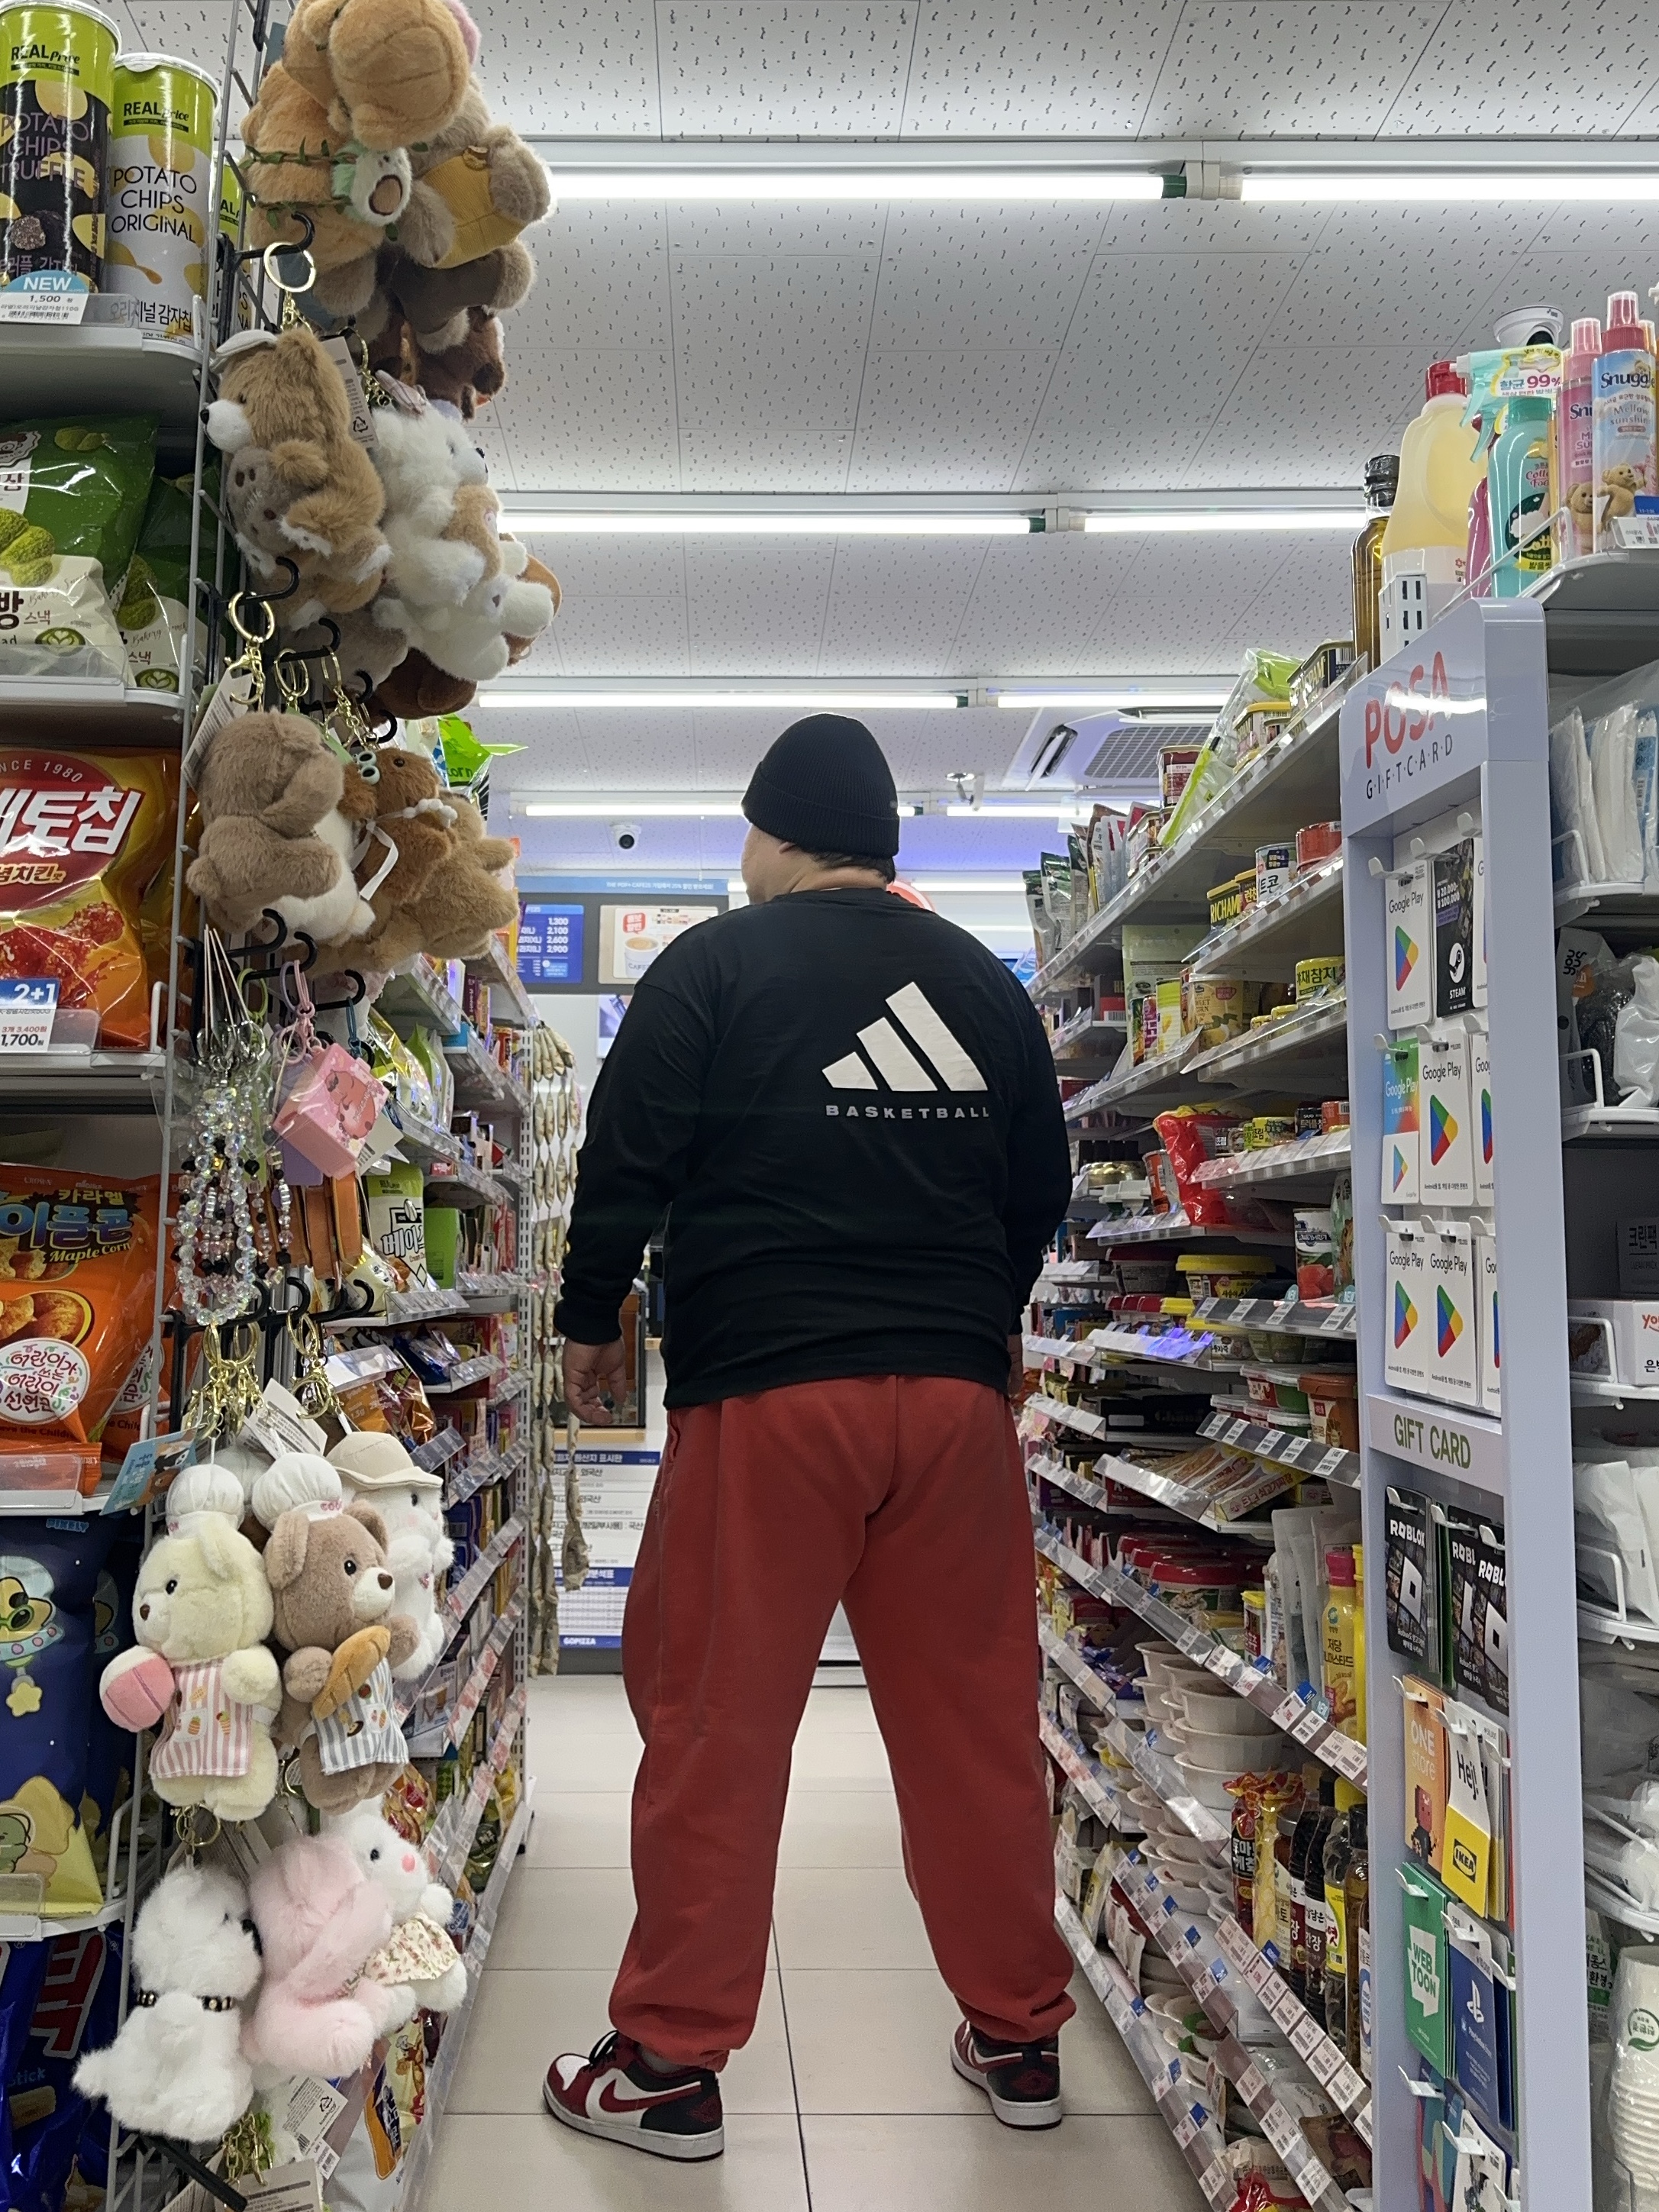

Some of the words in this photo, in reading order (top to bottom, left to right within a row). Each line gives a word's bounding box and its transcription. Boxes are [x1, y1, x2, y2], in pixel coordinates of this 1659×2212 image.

[124, 102, 161, 117] REAL
[114, 166, 197, 194] POTATO
[121, 189, 185, 214] CHIPS
[111, 214, 196, 244] ORIGINAL
[23, 277, 72, 291] NEW
[157, 303, 192, 334] 감자칩
[1499, 379, 1525, 391] 항균
[1600, 371, 1655, 390] Snuggle
[128, 650, 151, 664] 스낵
[1364, 651, 1451, 770] POSA
[43, 760, 83, 783] 1980
[1209, 896, 1239, 923] RICHAM
[1389, 893, 1411, 914] Google
[1411, 890, 1424, 907] Play
[14, 983, 56, 1005] 2+1
[1450, 987, 1466, 999] STEAM
[1422, 1064, 1446, 1083] Google
[1448, 1062, 1461, 1080] Play
[1385, 1080, 1406, 1099] Google
[1406, 1077, 1419, 1095] Play
[825, 1104, 989, 1120] BASKETBALL
[0, 1202, 133, 1250] 이플콘
[1628, 1224, 1657, 1250] 크린팩
[50, 1248, 100, 1264] Maple
[102, 1242, 131, 1254] Corn
[1389, 1250, 1410, 1271] Google
[1411, 1252, 1424, 1271] Play
[1430, 1253, 1453, 1274] Google
[1454, 1255, 1467, 1277] Play
[1393, 1413, 1424, 1453] GIFT
[1429, 1425, 1471, 1469] CARD
[1389, 1519, 1425, 1548] ROBLOX
[1451, 1541, 1476, 1566] ROBL
[1478, 1559, 1506, 1587] ROBL
[1327, 1638, 1342, 1652] 저당
[1411, 1720, 1435, 1757] ONE
[1412, 1750, 1436, 1781] store
[1456, 1749, 1479, 1801] Hej!
[1455, 1848, 1474, 1873] IKEA
[1412, 1942, 1432, 1973] WEB
[1411, 1963, 1436, 1998] TOON
